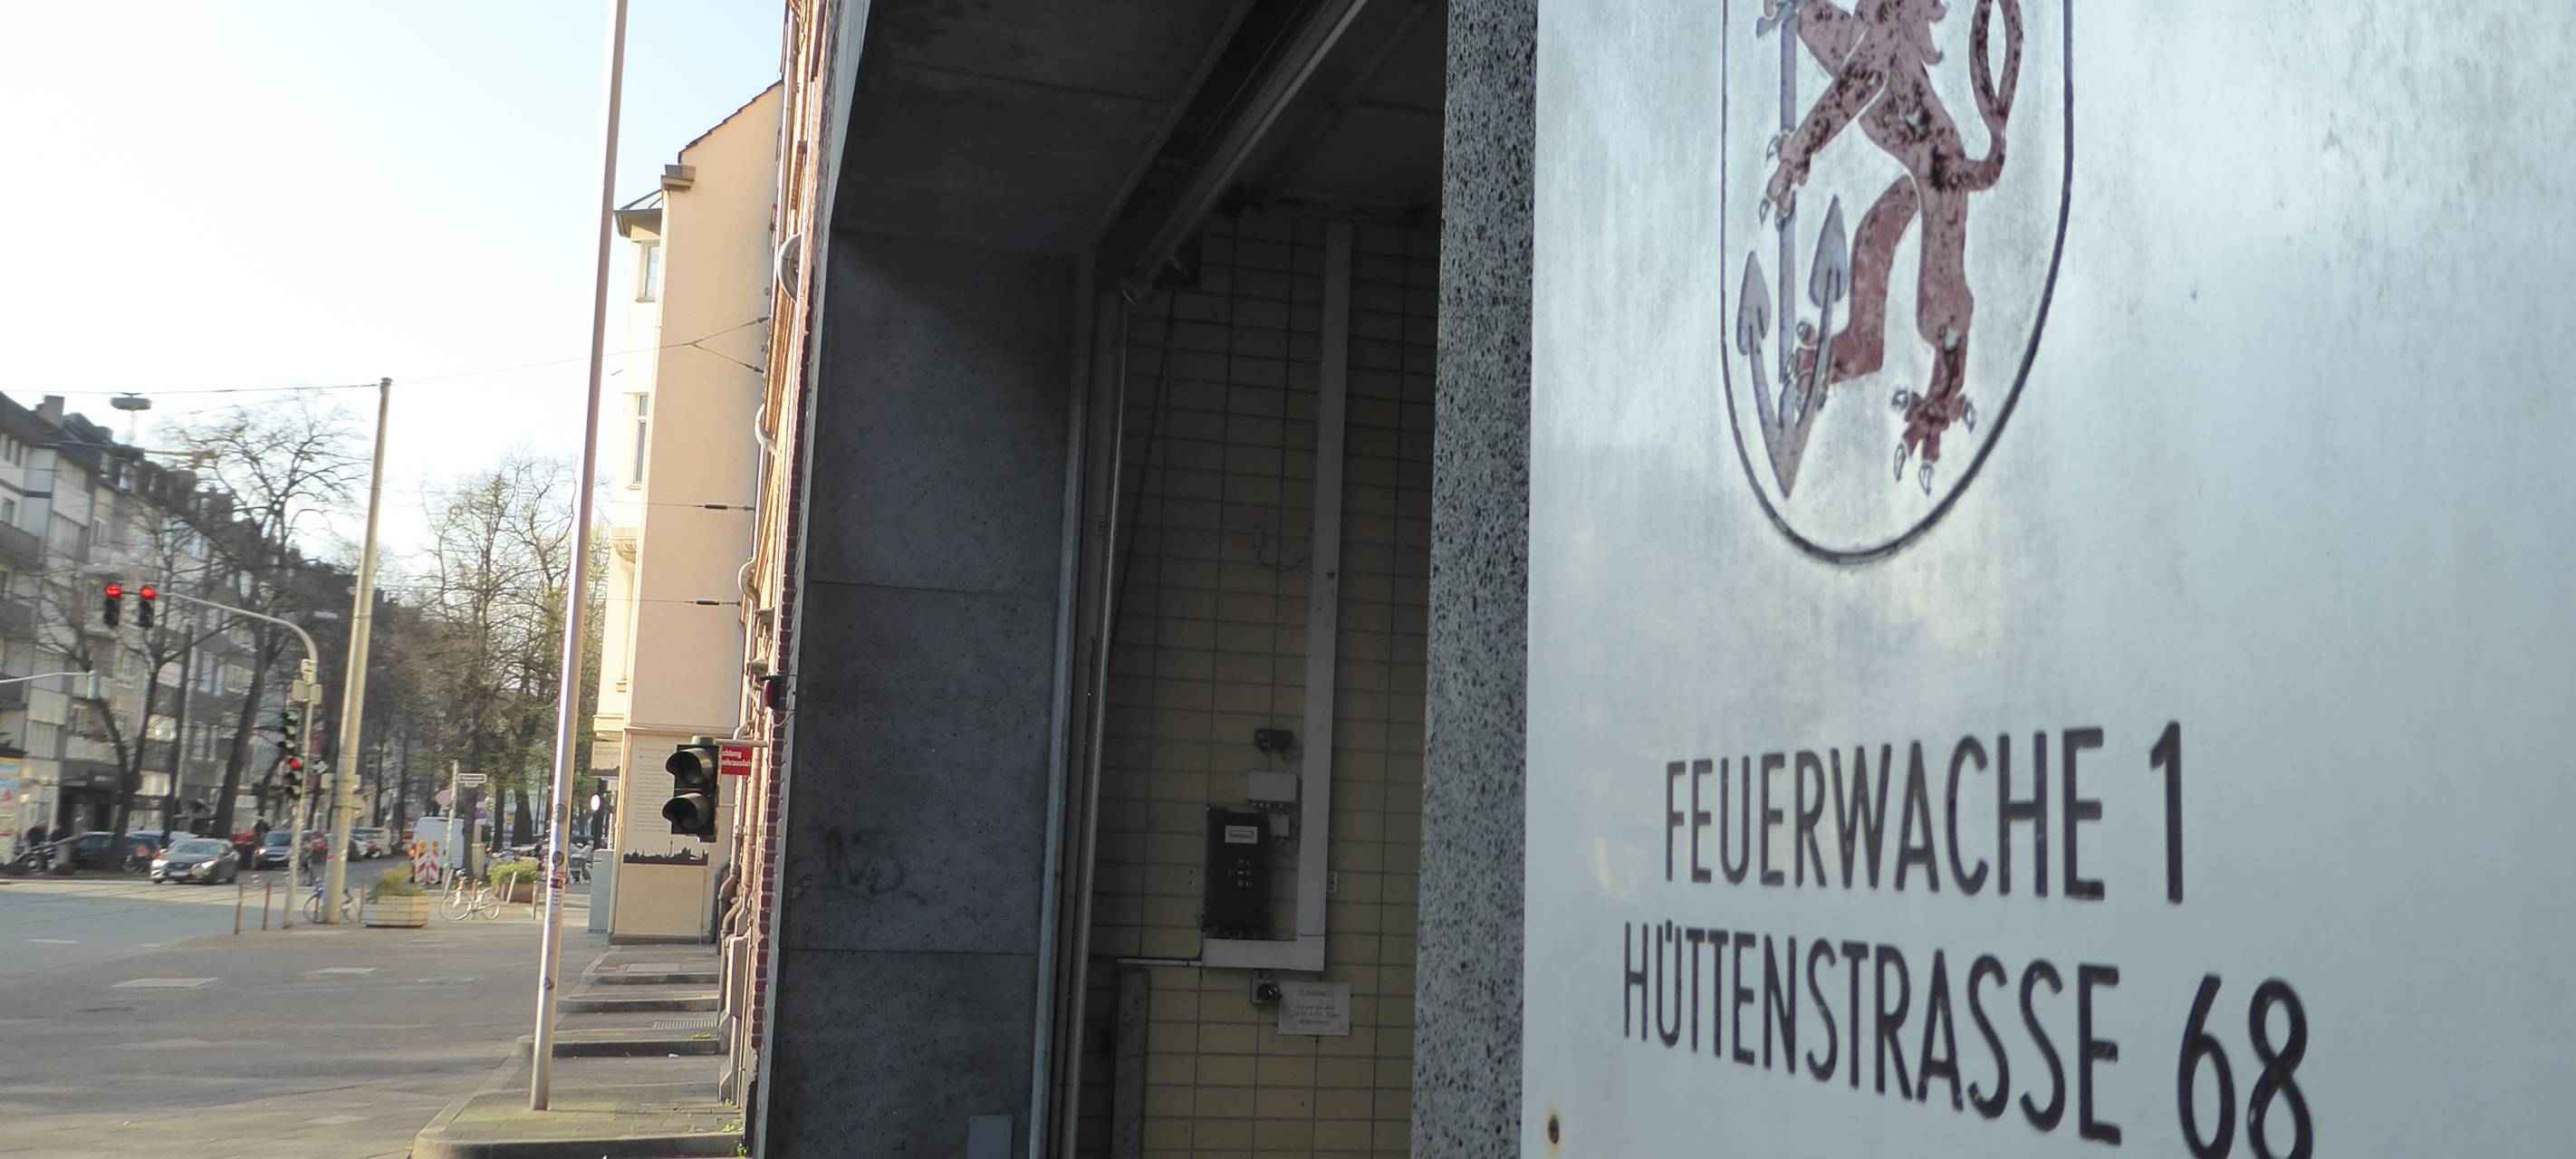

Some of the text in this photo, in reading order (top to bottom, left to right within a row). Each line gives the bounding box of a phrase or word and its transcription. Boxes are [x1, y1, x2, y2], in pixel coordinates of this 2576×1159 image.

[722, 748, 742, 759] chtung
[1665, 720, 2184, 904] FEUERWACHE 1
[1624, 919, 2315, 1159] HÜTTENSTRASSE 68
